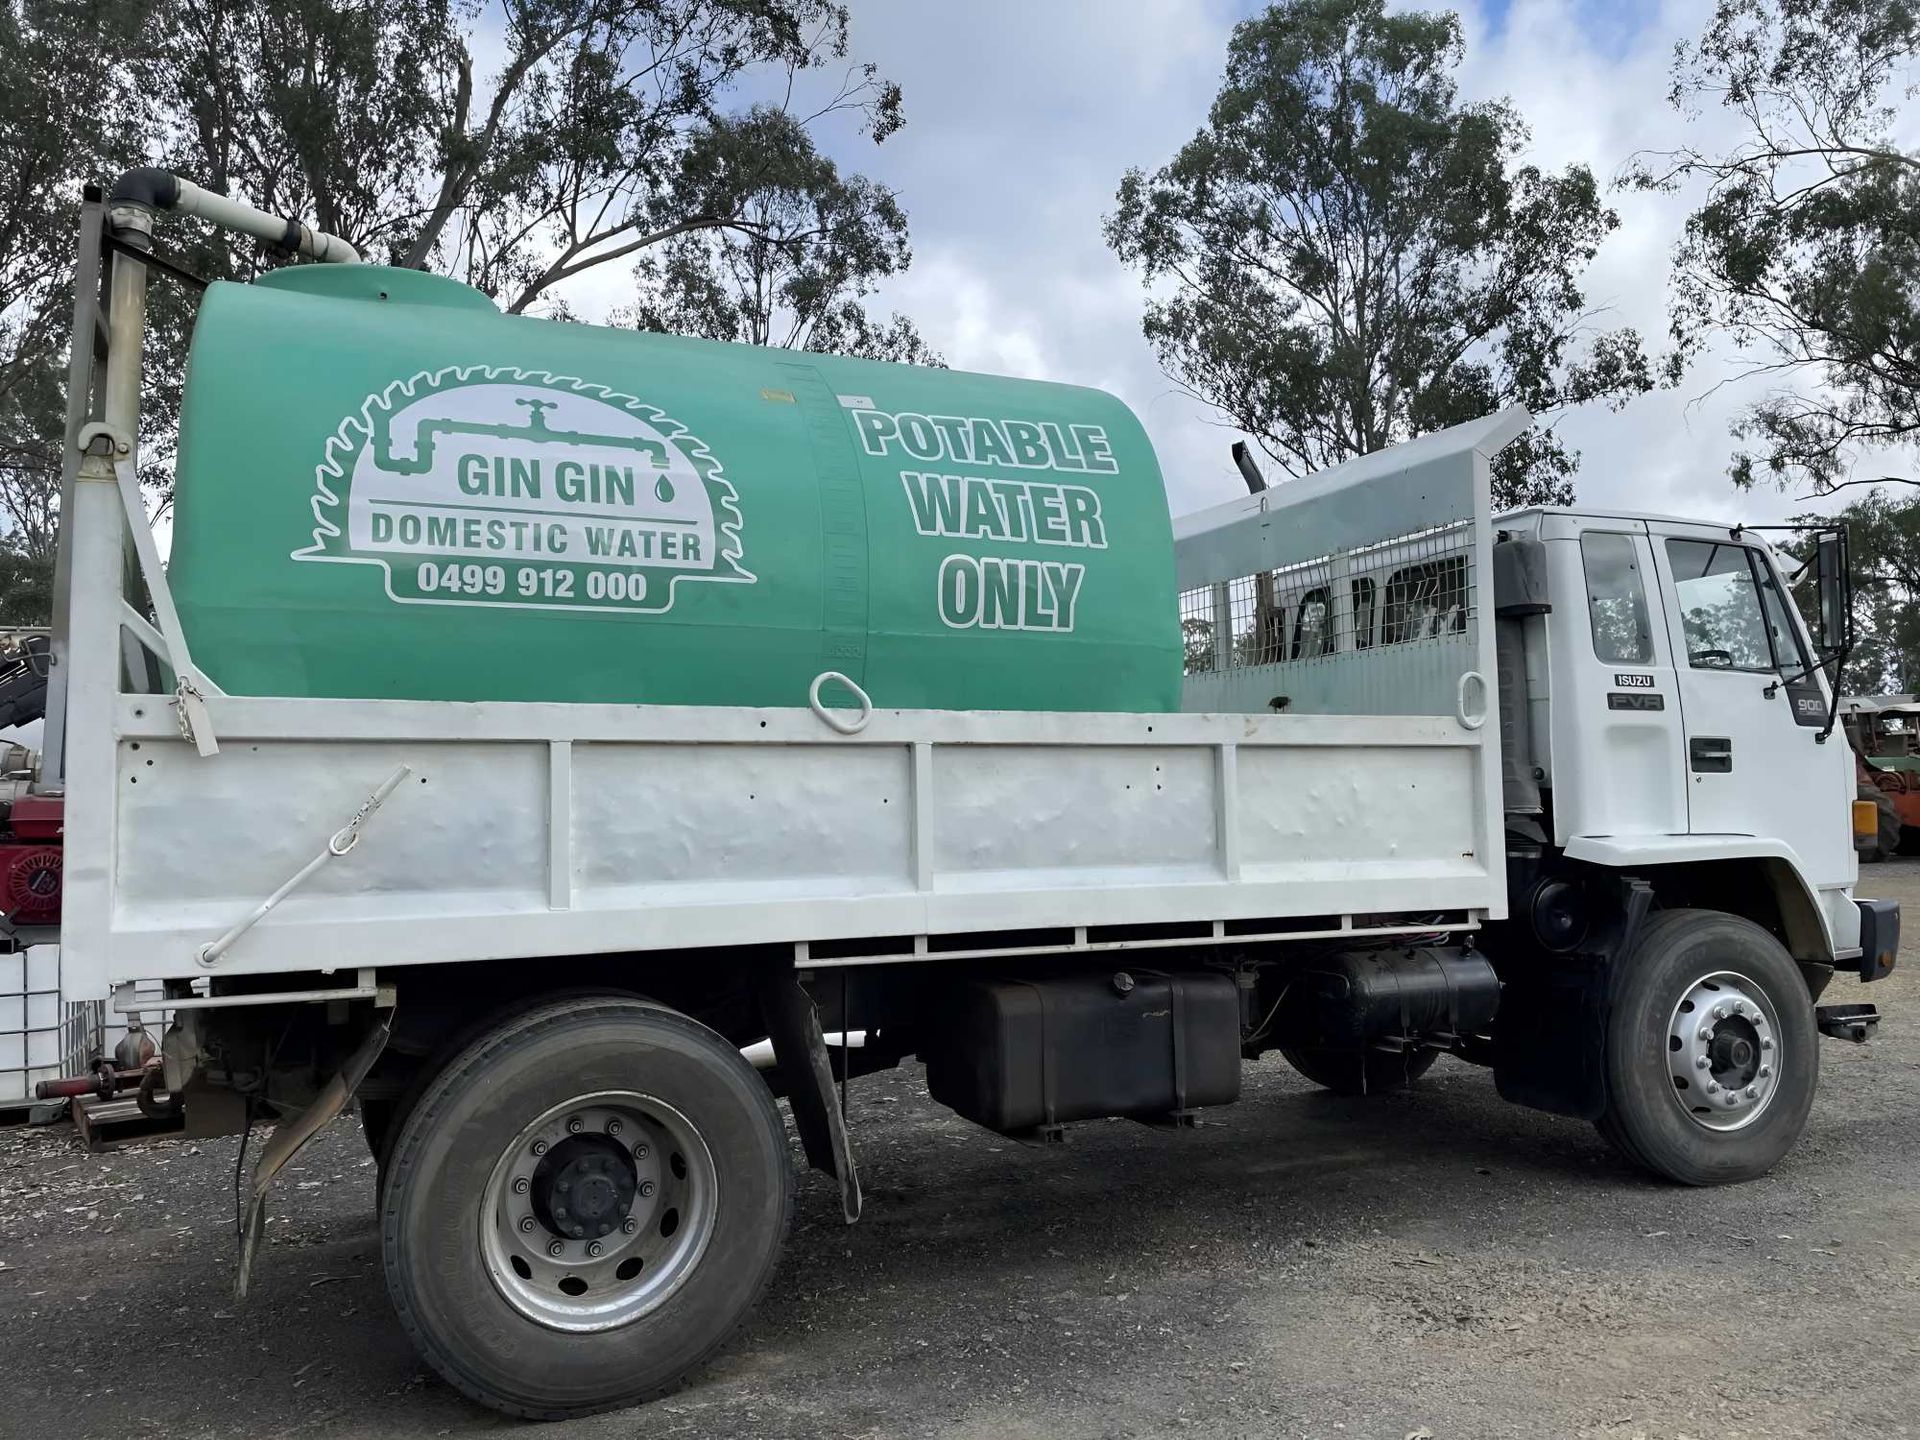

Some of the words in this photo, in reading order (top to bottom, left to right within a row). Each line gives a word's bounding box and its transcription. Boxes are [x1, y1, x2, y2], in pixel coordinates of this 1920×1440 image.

[852, 409, 1120, 475] POTABLE
[457, 453, 541, 499] GIN
[554, 459, 636, 505] GIN
[900, 471, 1108, 549] WATER
[371, 513, 568, 554] DOMESTIC
[585, 527, 702, 562] WATER
[418, 563, 506, 596] 0499
[518, 567, 575, 598] 912
[586, 571, 647, 601] 000
[938, 553, 1085, 632] ONLY
[1618, 675, 1651, 687] ISUZU
[1798, 699, 1823, 711] 900
